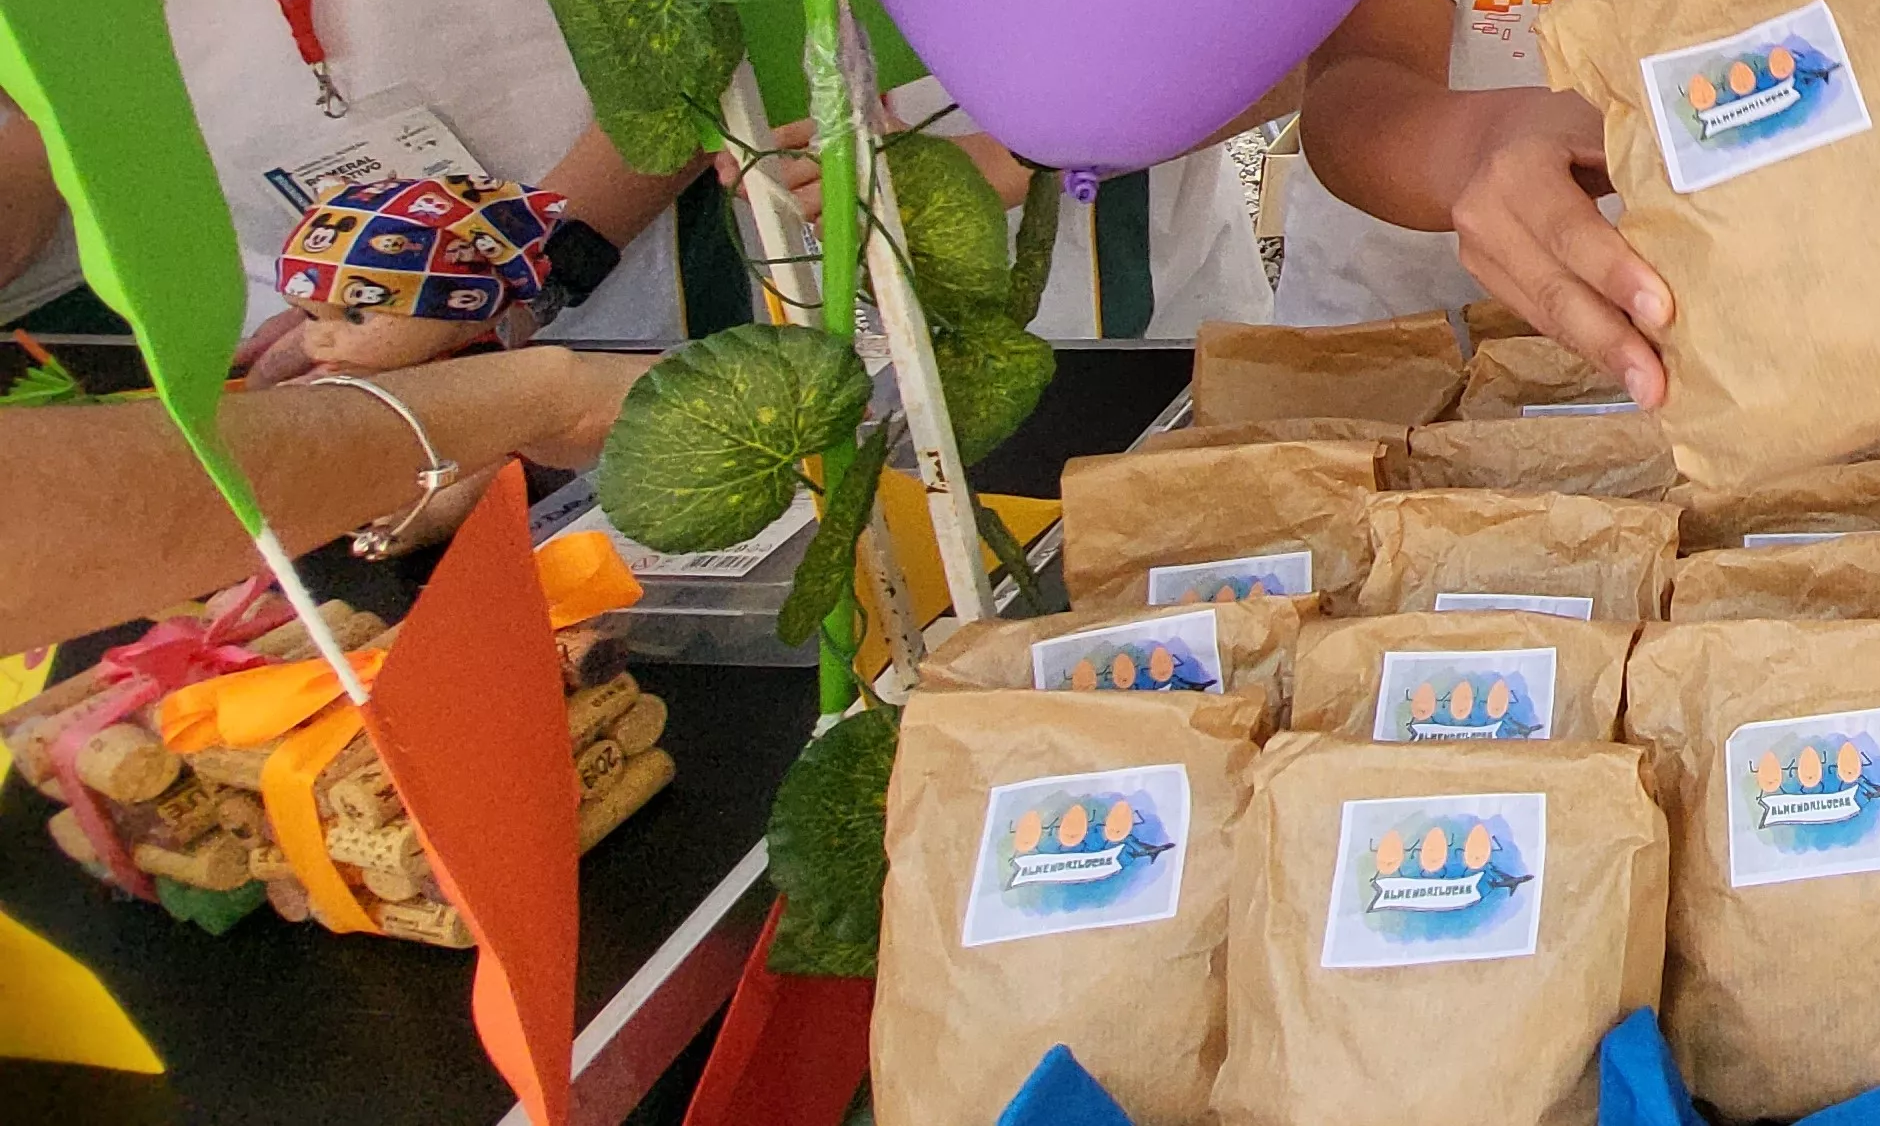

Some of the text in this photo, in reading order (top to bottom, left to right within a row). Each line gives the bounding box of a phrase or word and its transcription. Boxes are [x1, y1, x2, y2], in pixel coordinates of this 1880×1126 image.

[1771, 796, 1852, 817] ALMENDRILOCAS
[1021, 855, 1113, 878] ALMENDRILOCAS
[1384, 883, 1473, 901] ALMENDRILOCAS
